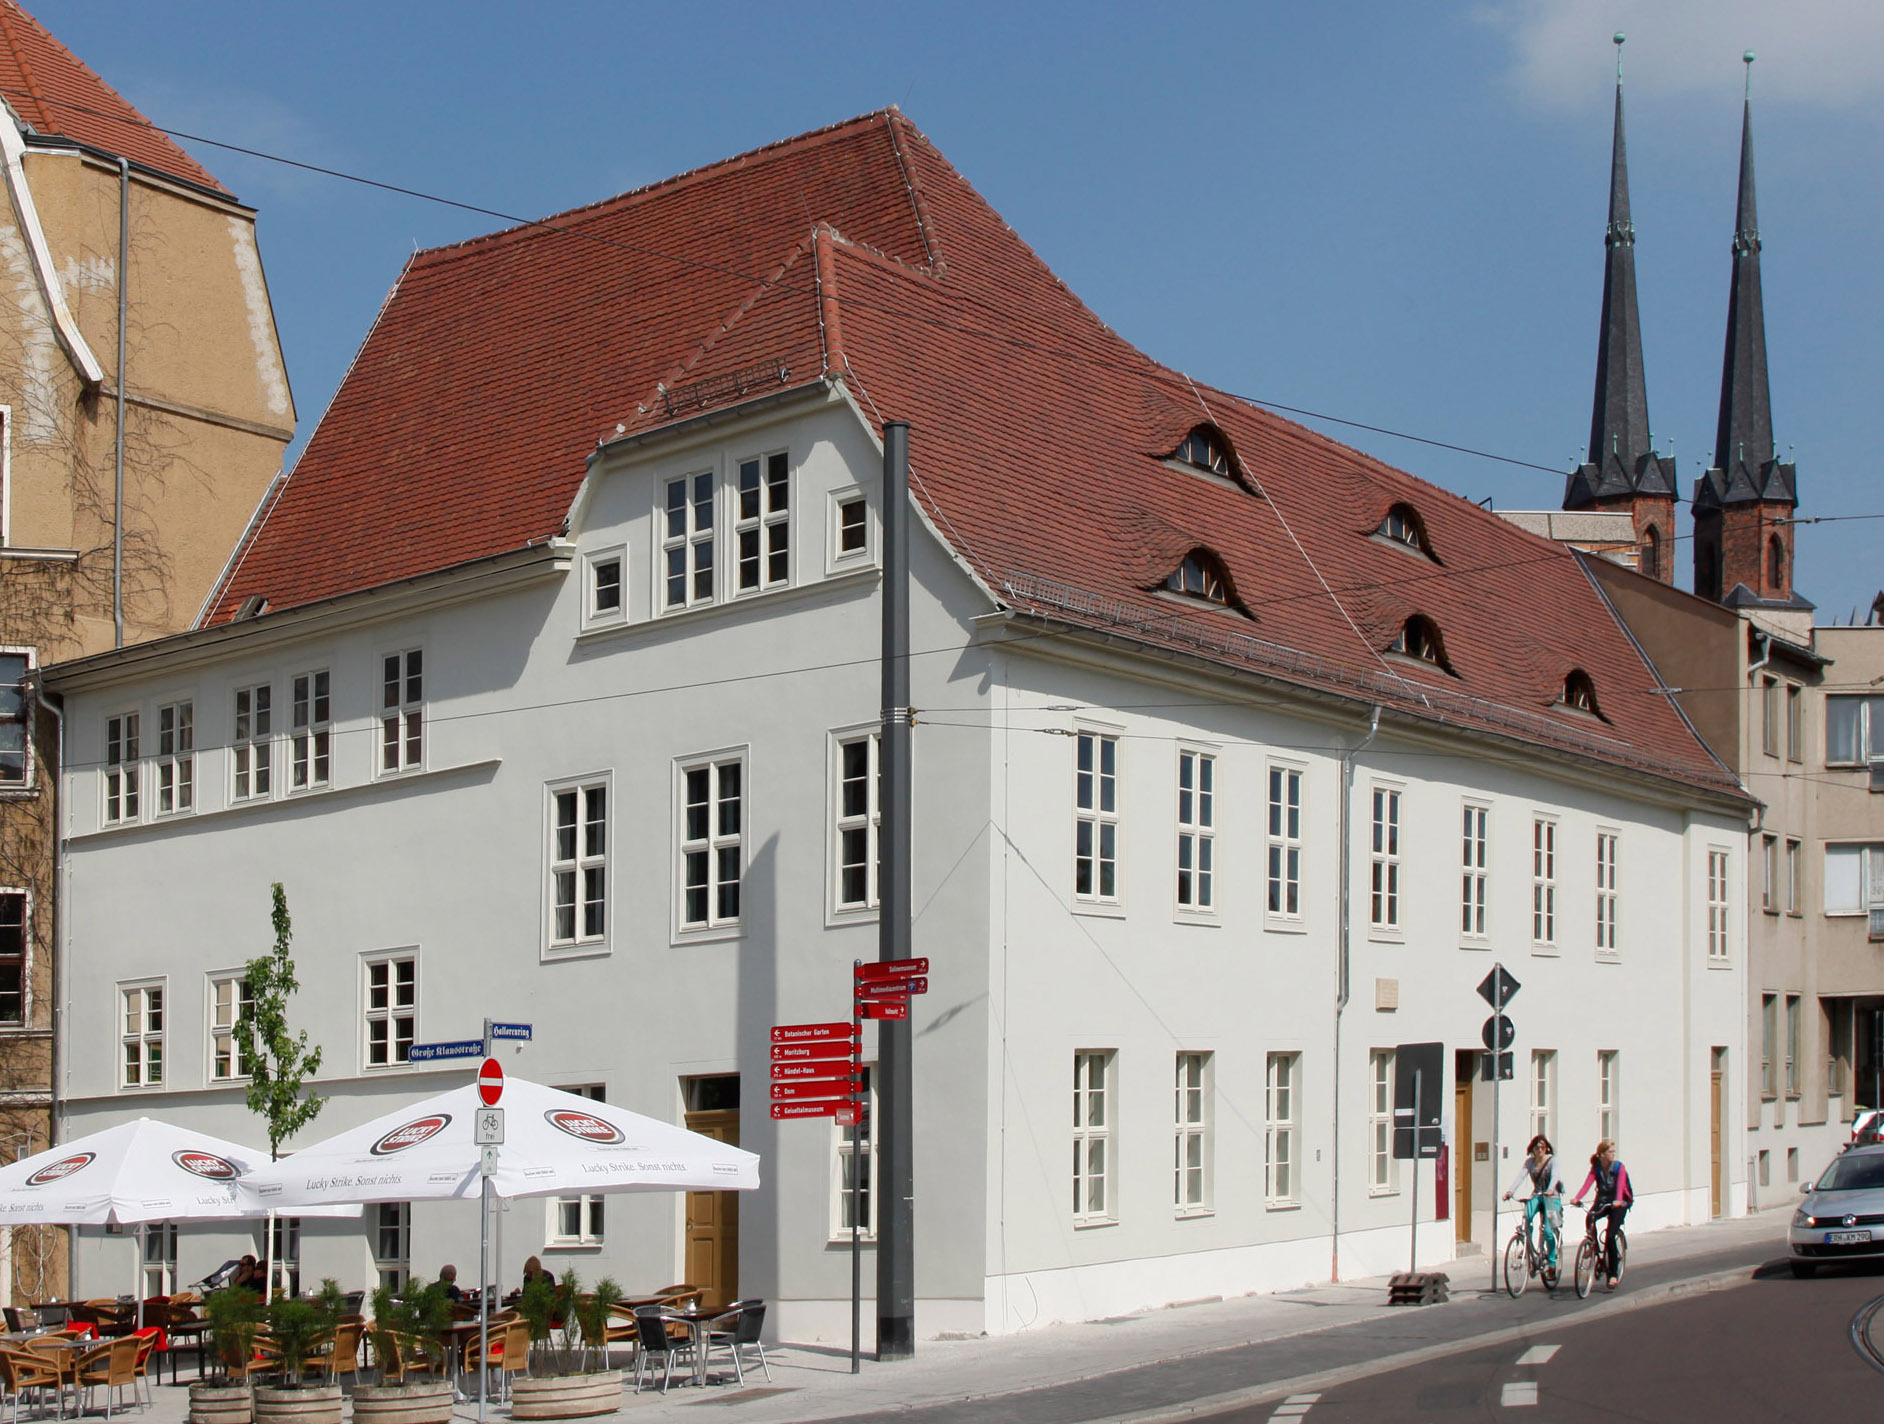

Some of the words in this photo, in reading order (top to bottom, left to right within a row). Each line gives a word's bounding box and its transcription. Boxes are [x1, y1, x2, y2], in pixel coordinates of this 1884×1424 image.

[411, 1047, 434, 1058] Große
[436, 1043, 481, 1056] Klausstraße
[559, 1119, 599, 1127] LUCKY
[398, 1125, 437, 1136] LUCKY
[568, 1126, 613, 1134] STRIKE
[385, 1134, 428, 1145] STRIKE
[582, 1162, 609, 1174] Lucky
[638, 1161, 661, 1171] Sonst
[662, 1161, 687, 1171] nichts.
[306, 1177, 329, 1191] Lucky
[355, 1175, 377, 1186] Sonst
[379, 1174, 402, 1184] nichts.
[196, 1196, 221, 1206] Lucky
